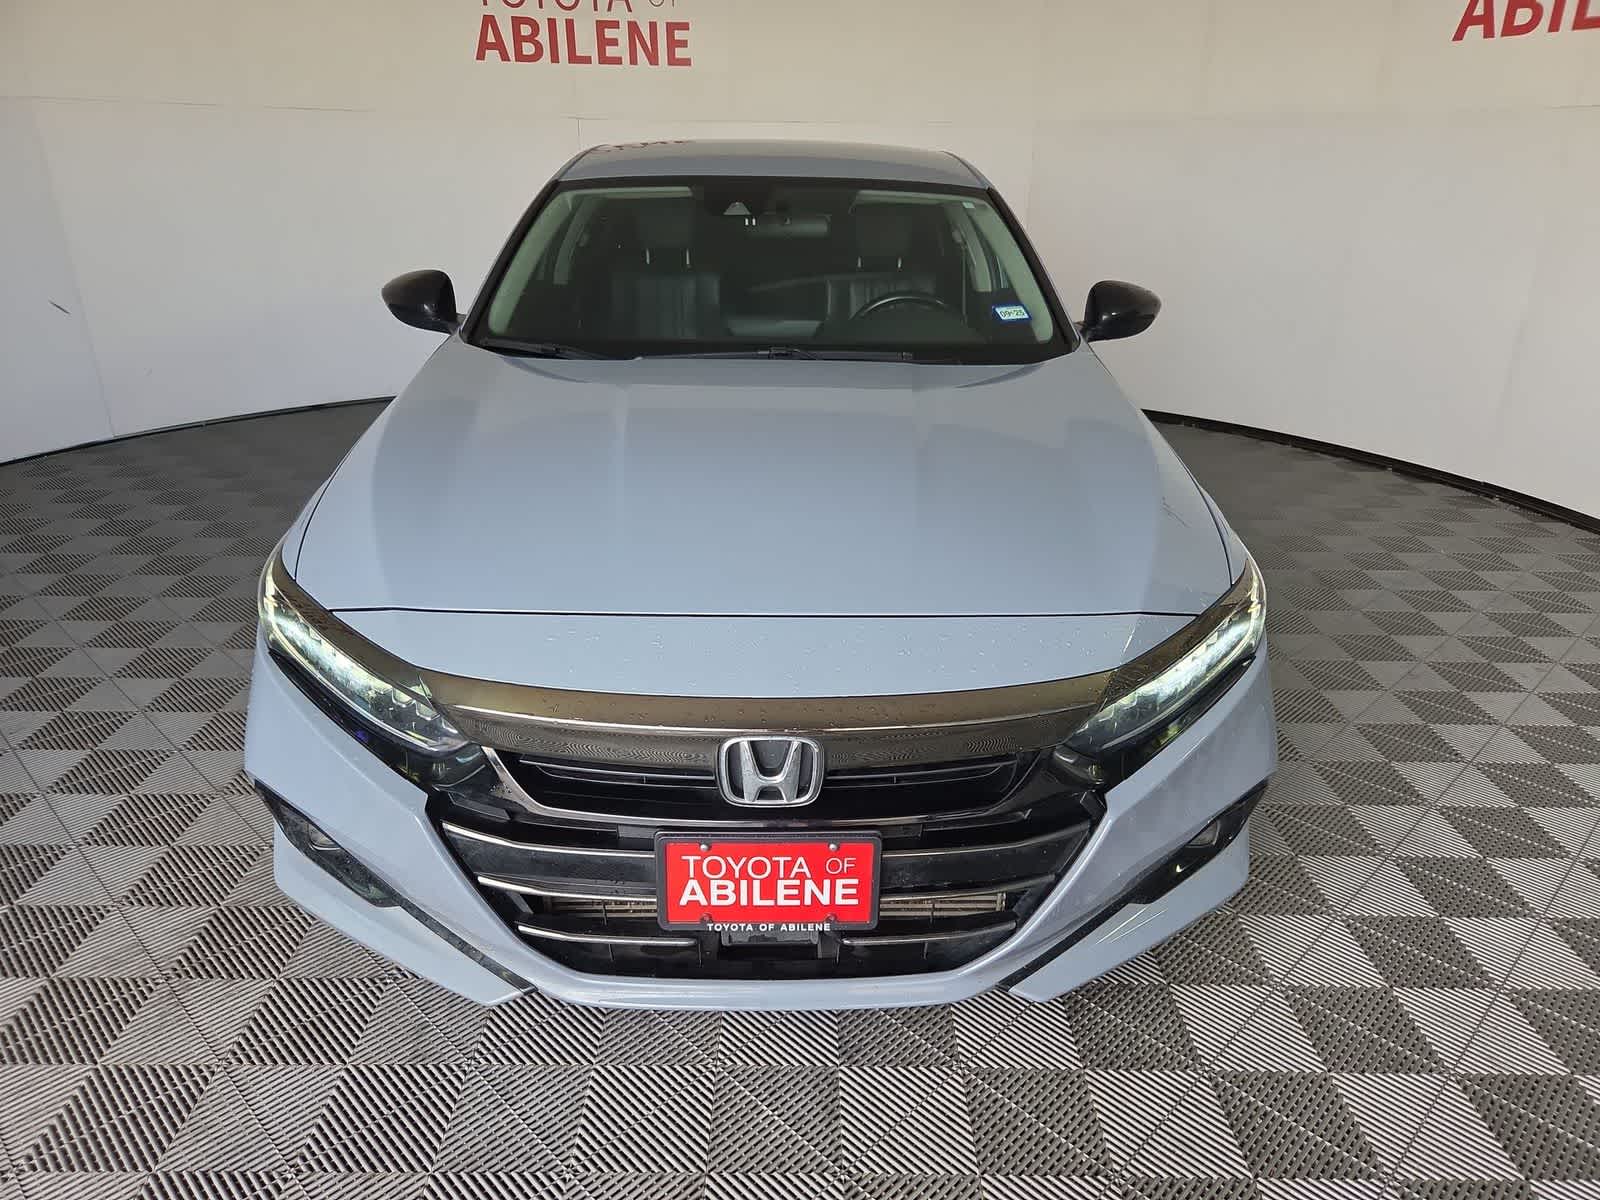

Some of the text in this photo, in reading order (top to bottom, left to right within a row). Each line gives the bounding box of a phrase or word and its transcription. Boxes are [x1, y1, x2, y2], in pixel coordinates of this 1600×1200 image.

[475, 14, 692, 66] ABILENE
[681, 855, 856, 879] TOYOTA OF
[679, 878, 859, 906] ABILENE
[707, 923, 831, 932] TOYOTA OF ABILENE
